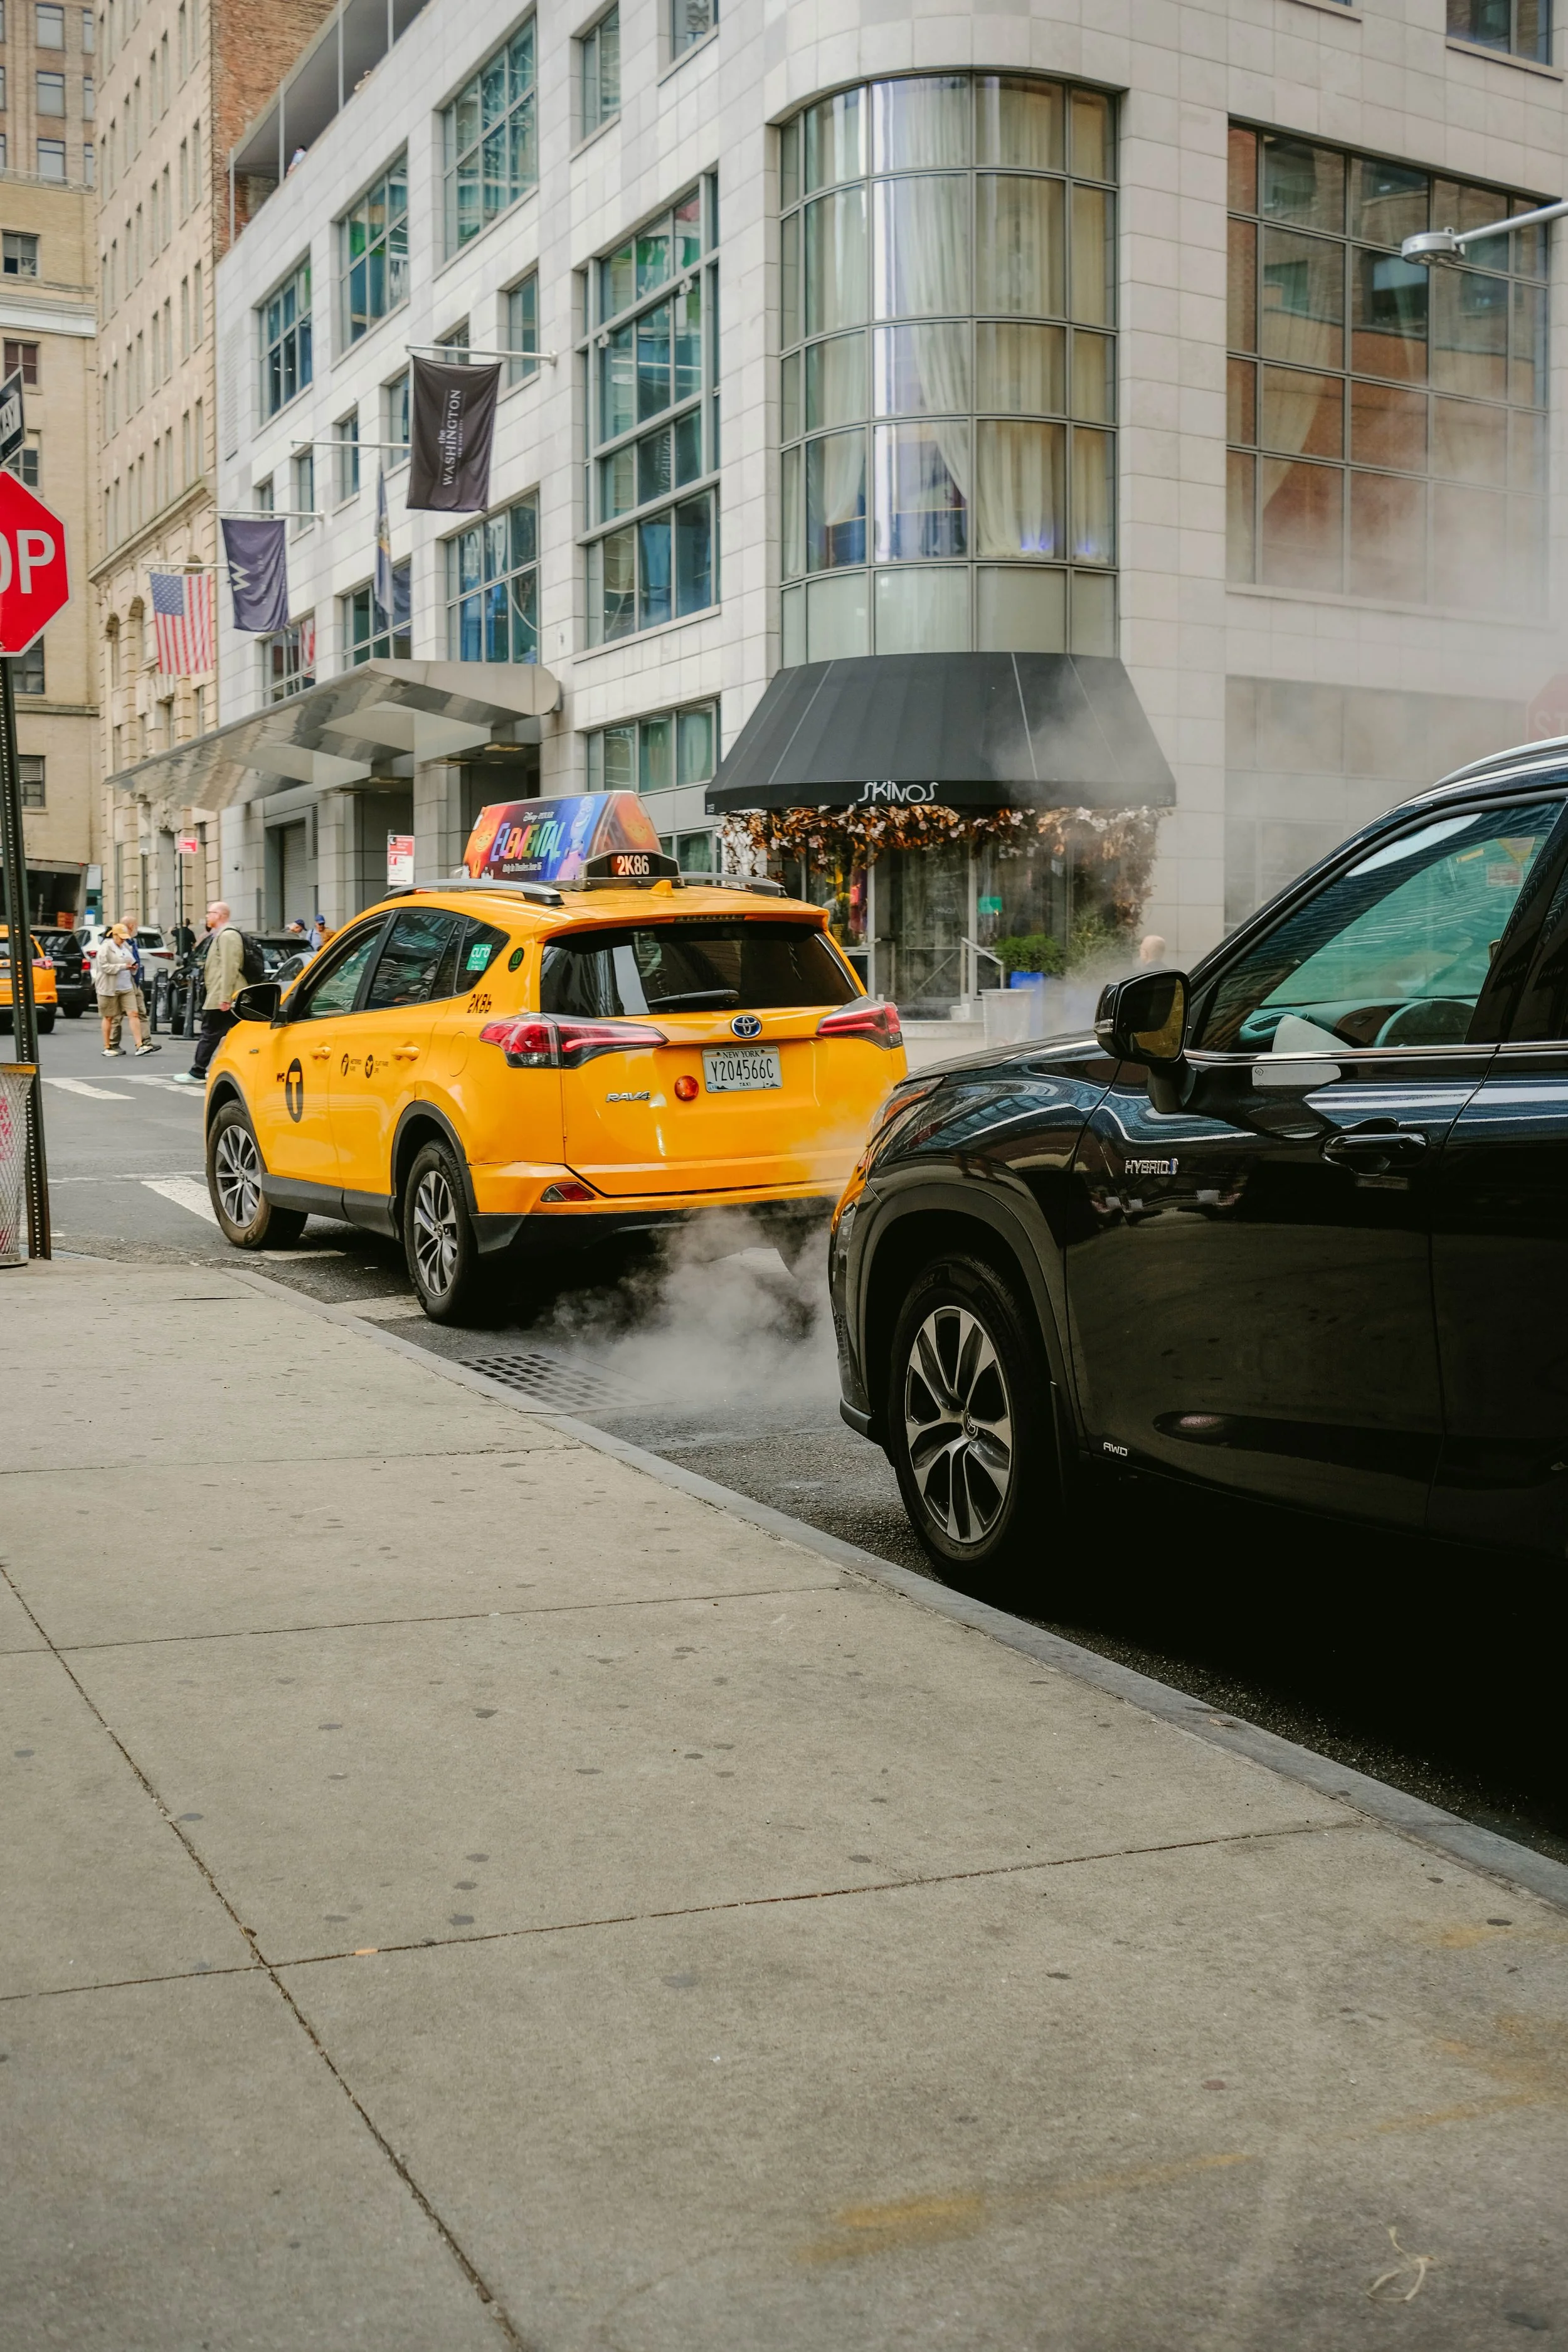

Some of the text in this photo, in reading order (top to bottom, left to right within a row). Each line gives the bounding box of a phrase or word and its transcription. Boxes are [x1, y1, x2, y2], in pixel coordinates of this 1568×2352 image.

[437, 430, 446, 444] the
[442, 389, 462, 485] WASHINGTON
[490, 820, 566, 862] ELEMENTAL
[617, 855, 649, 875] 2K86
[470, 946, 490, 958] curb
[740, 1050, 760, 1058] YORK
[711, 1058, 773, 1081] Y204566C
[605, 1091, 651, 1103] RAV4
[1125, 1160, 1170, 1175] HYBRID
[1103, 1441, 1128, 1456] AWD
